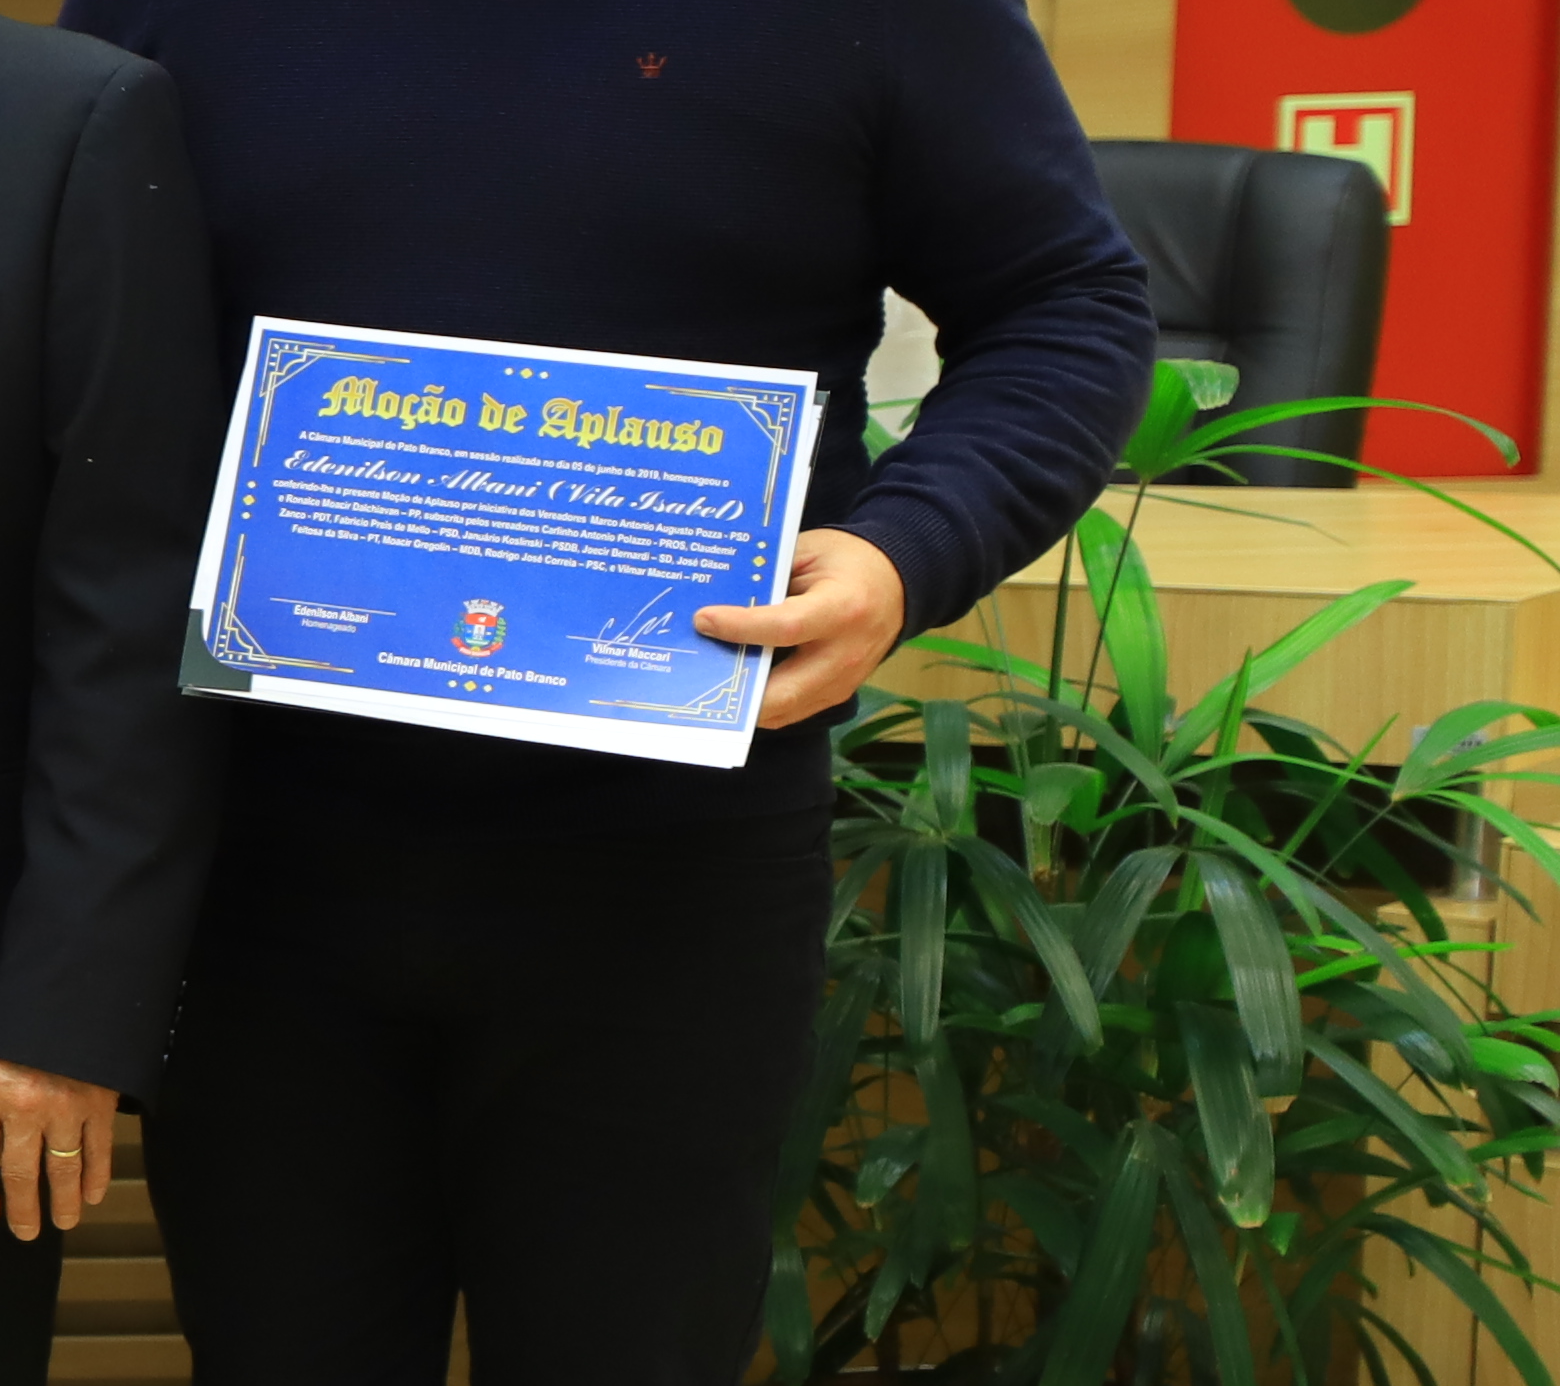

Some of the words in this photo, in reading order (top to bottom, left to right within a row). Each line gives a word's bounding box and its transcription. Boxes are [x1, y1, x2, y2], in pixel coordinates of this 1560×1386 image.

[317, 375, 467, 430] Moção
[477, 391, 528, 434] de
[537, 396, 724, 455] Aplauso
[292, 603, 339, 619] Edenilson
[337, 609, 369, 623] Albani
[592, 641, 627, 656] Vilmar
[626, 646, 671, 662] Maccari
[377, 651, 421, 668] Câmara
[422, 657, 478, 676] Municipal
[478, 664, 495, 677] de
[495, 666, 524, 681] Pato
[522, 669, 567, 686] Branco
